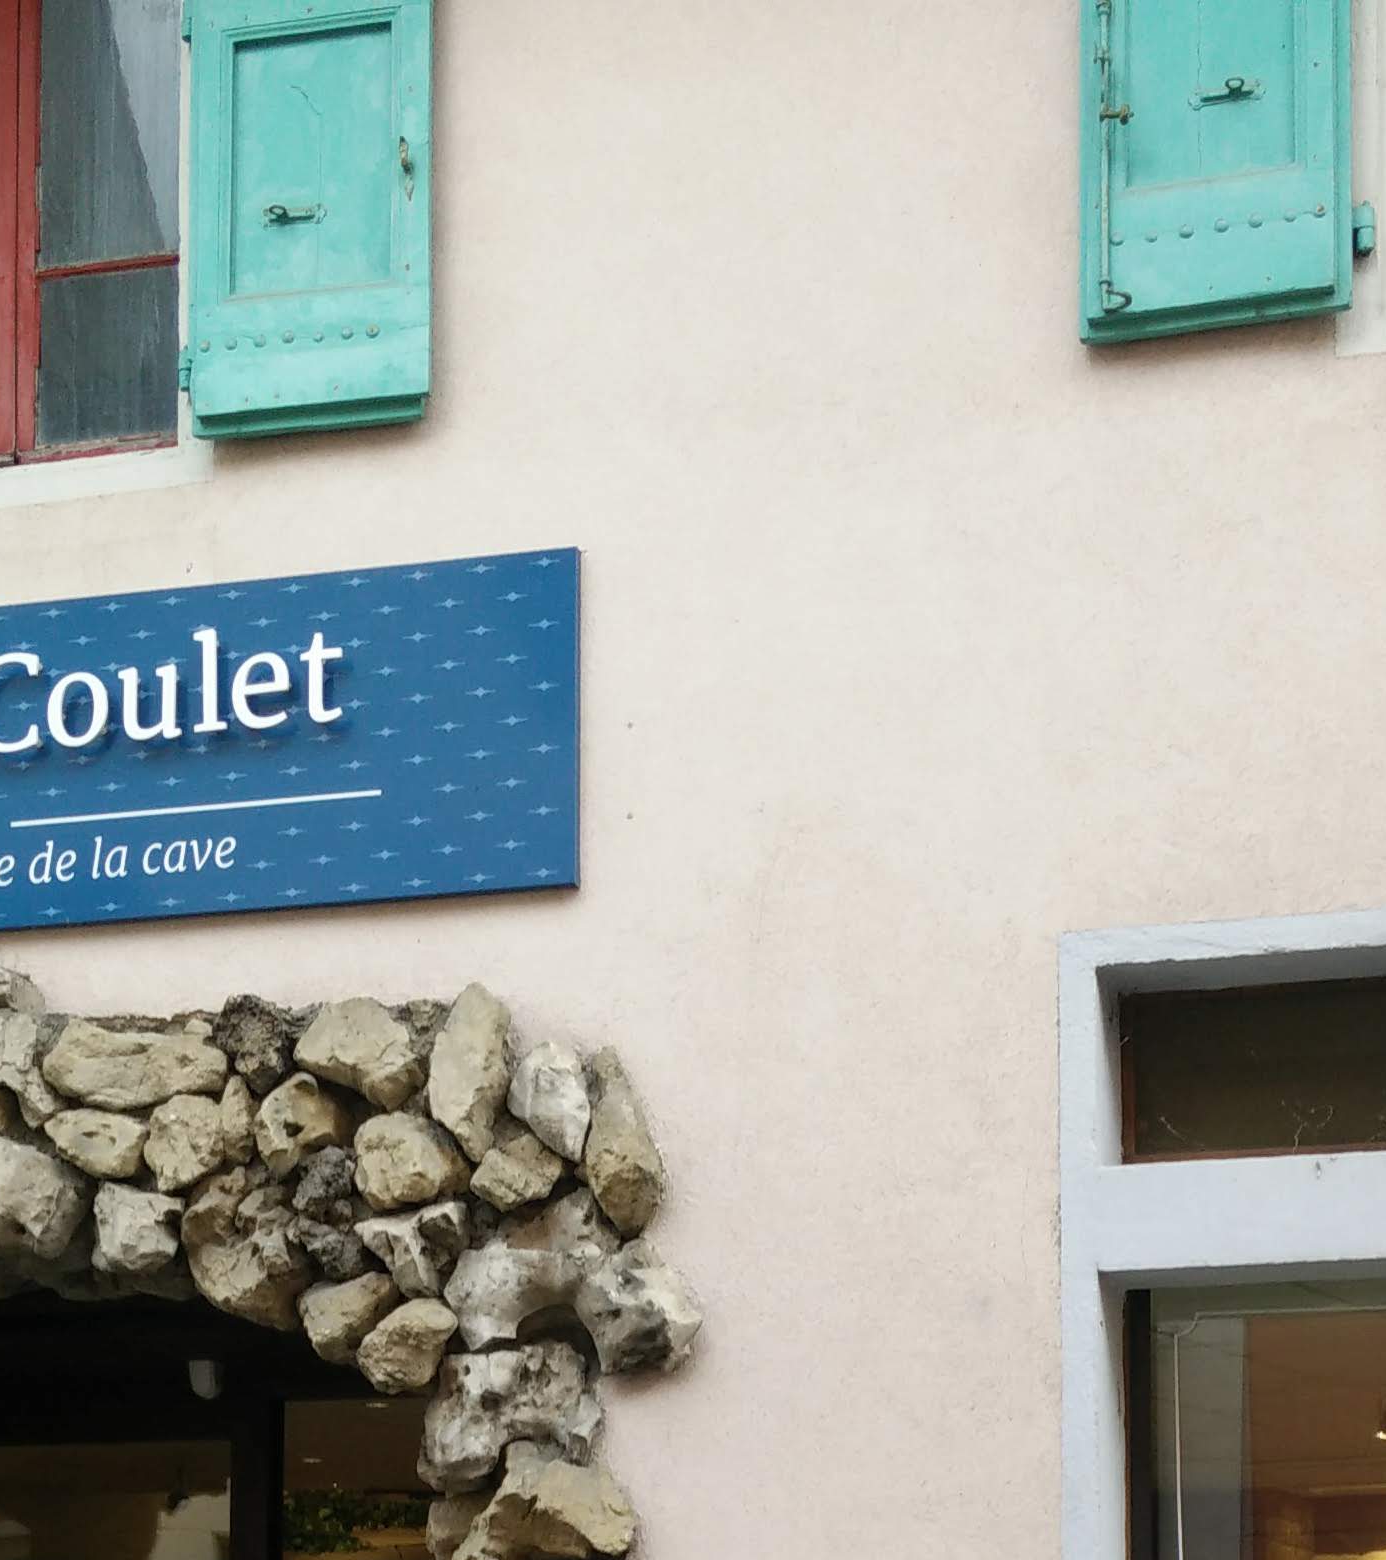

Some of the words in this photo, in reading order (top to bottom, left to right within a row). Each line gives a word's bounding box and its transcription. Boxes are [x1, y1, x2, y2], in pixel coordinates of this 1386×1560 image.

[28, 838, 77, 884] de
[91, 836, 128, 880] la
[142, 834, 239, 876] cave
